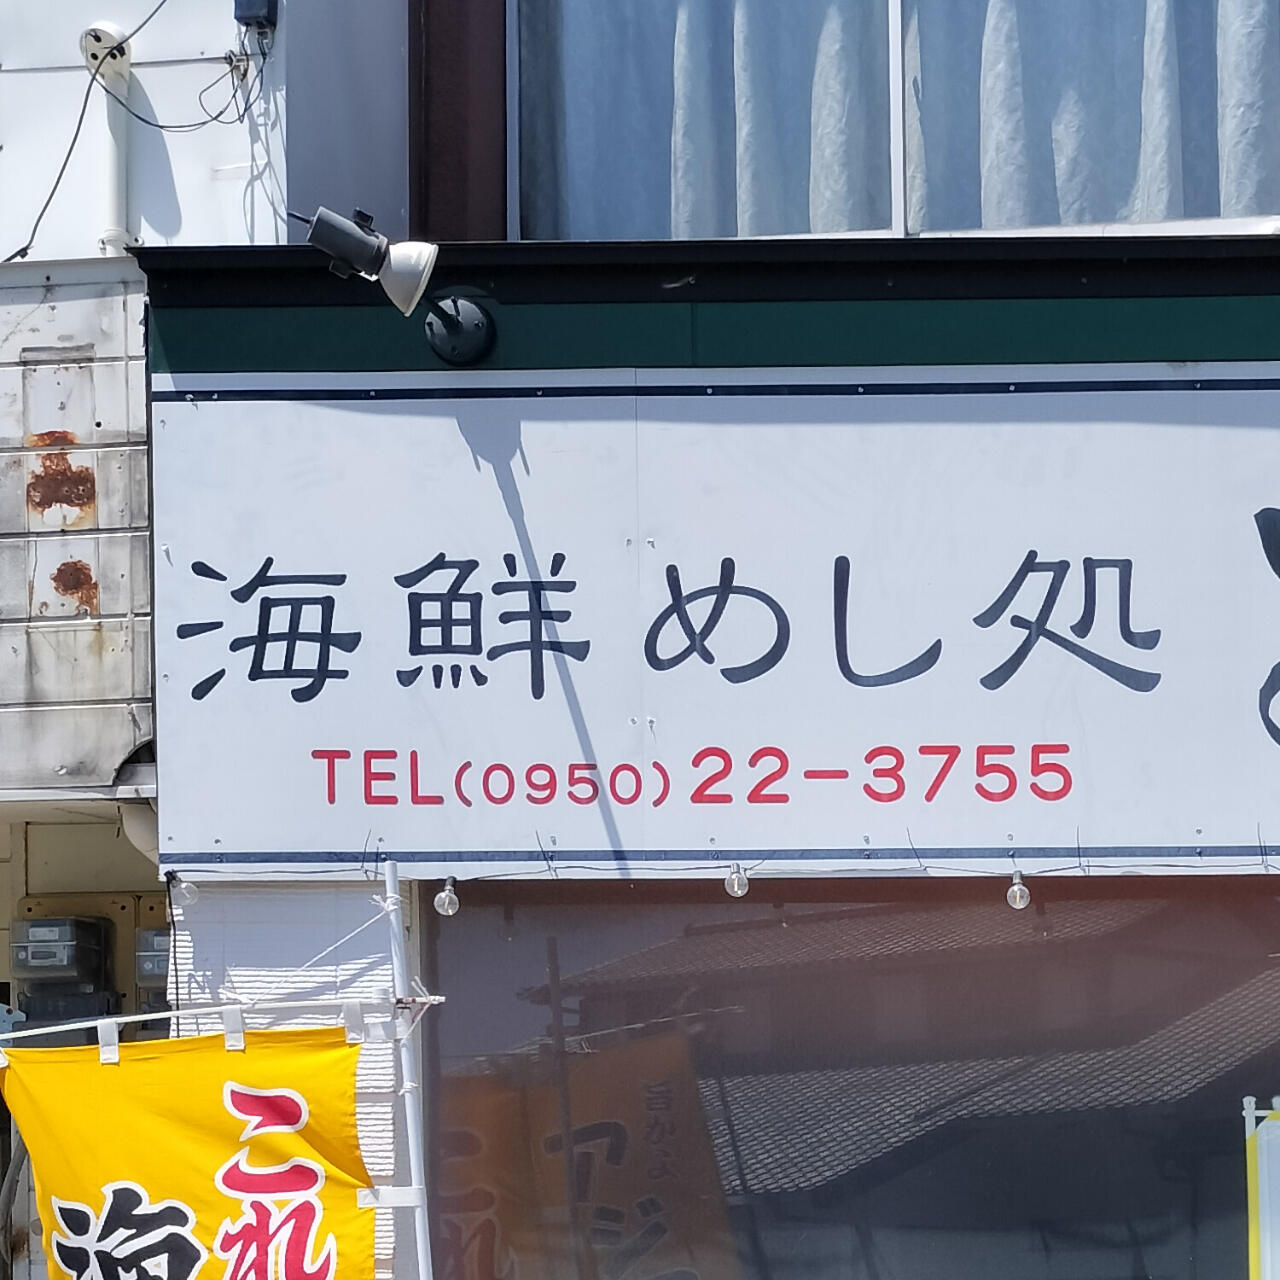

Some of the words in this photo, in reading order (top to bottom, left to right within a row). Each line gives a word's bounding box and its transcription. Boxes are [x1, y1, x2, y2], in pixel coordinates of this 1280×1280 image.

[176, 549, 1162, 702] 海鮮めし処
